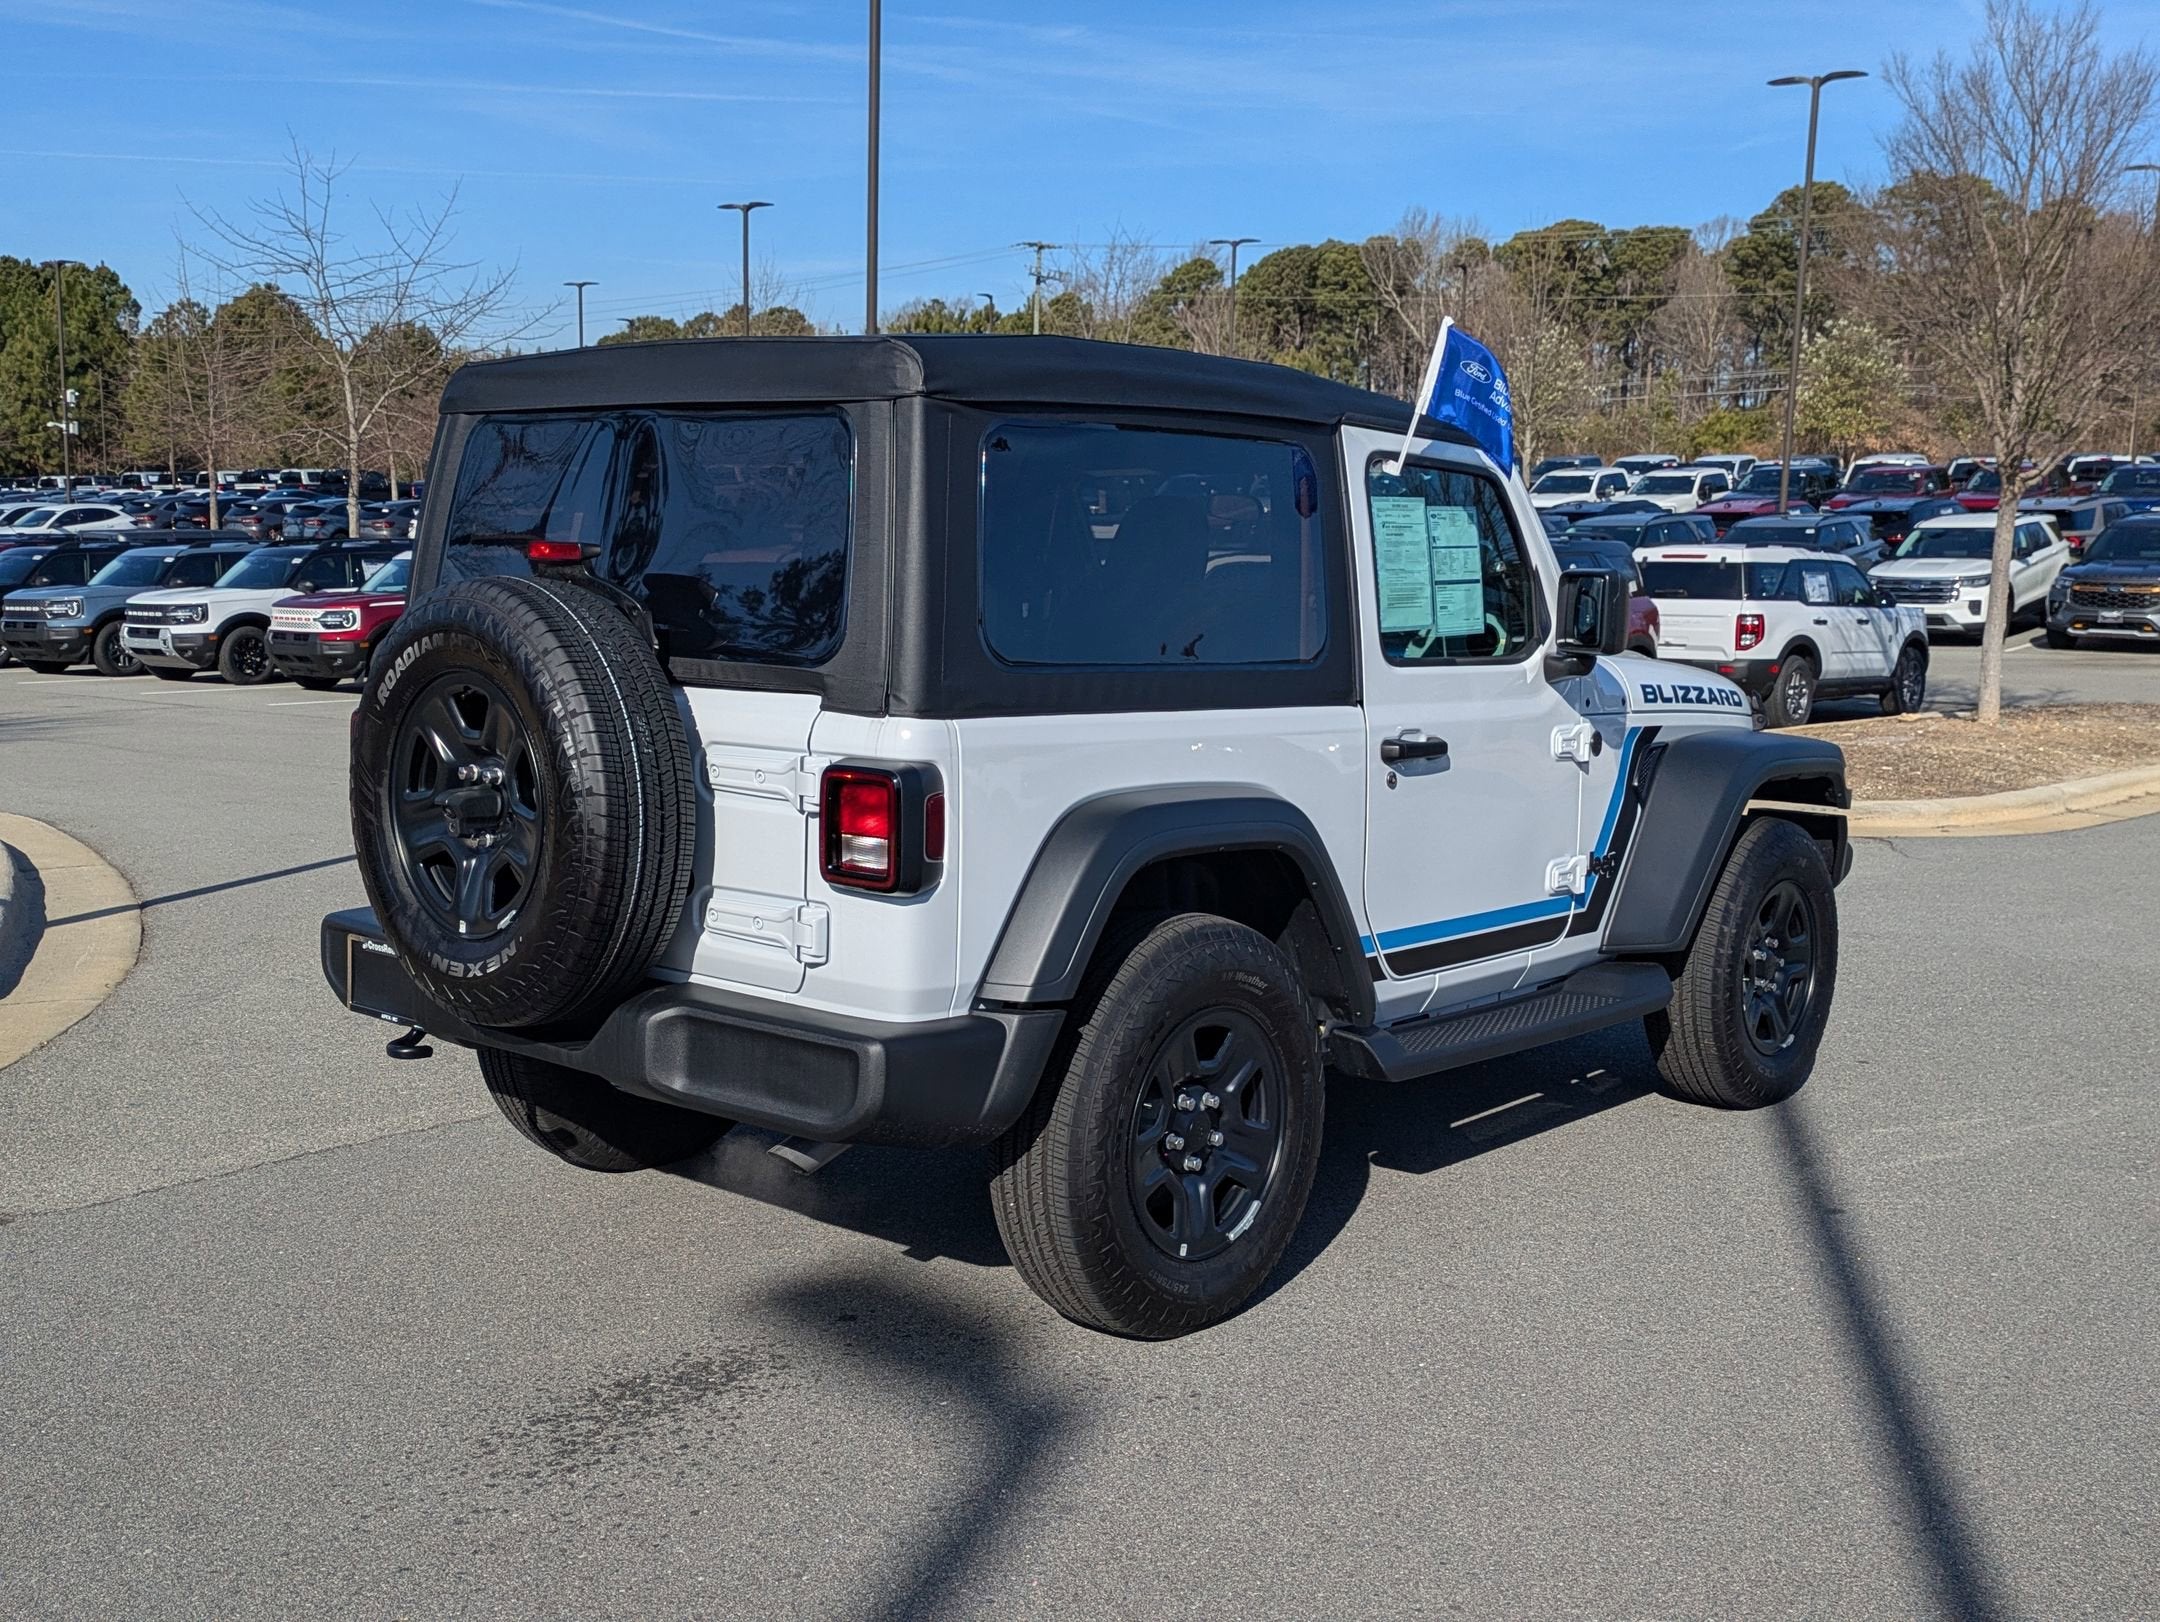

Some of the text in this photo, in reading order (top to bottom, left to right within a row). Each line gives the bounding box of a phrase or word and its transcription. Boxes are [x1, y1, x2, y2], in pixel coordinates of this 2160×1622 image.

[1454, 389, 1470, 401] Blue
[1472, 398, 1492, 416] Certified
[376, 632, 444, 707] ROADIAN
[1640, 684, 1743, 707] BLIZZARD
[1586, 851, 1616, 879] Jeep
[430, 939, 517, 978] NEXEN
